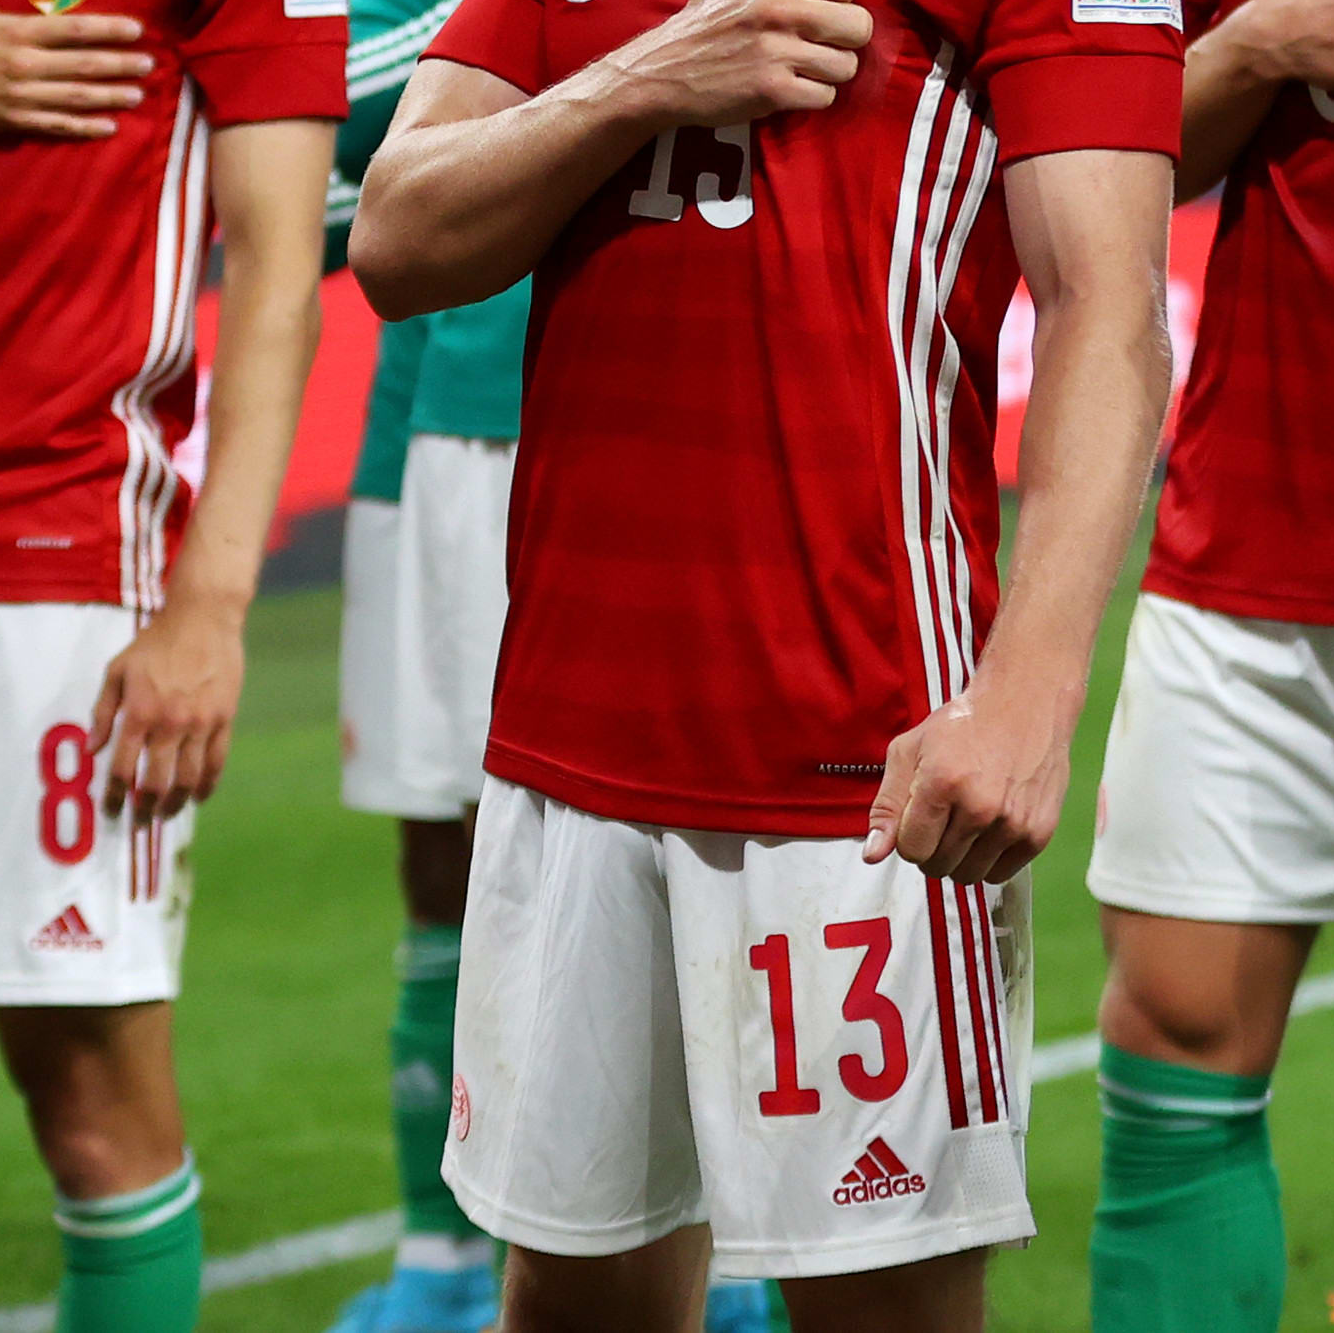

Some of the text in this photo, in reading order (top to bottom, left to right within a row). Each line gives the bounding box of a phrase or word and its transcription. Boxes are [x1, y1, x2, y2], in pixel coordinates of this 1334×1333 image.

[38, 722, 95, 866] 8
[750, 916, 909, 1117] 13
[833, 1172, 926, 1206] adidas
